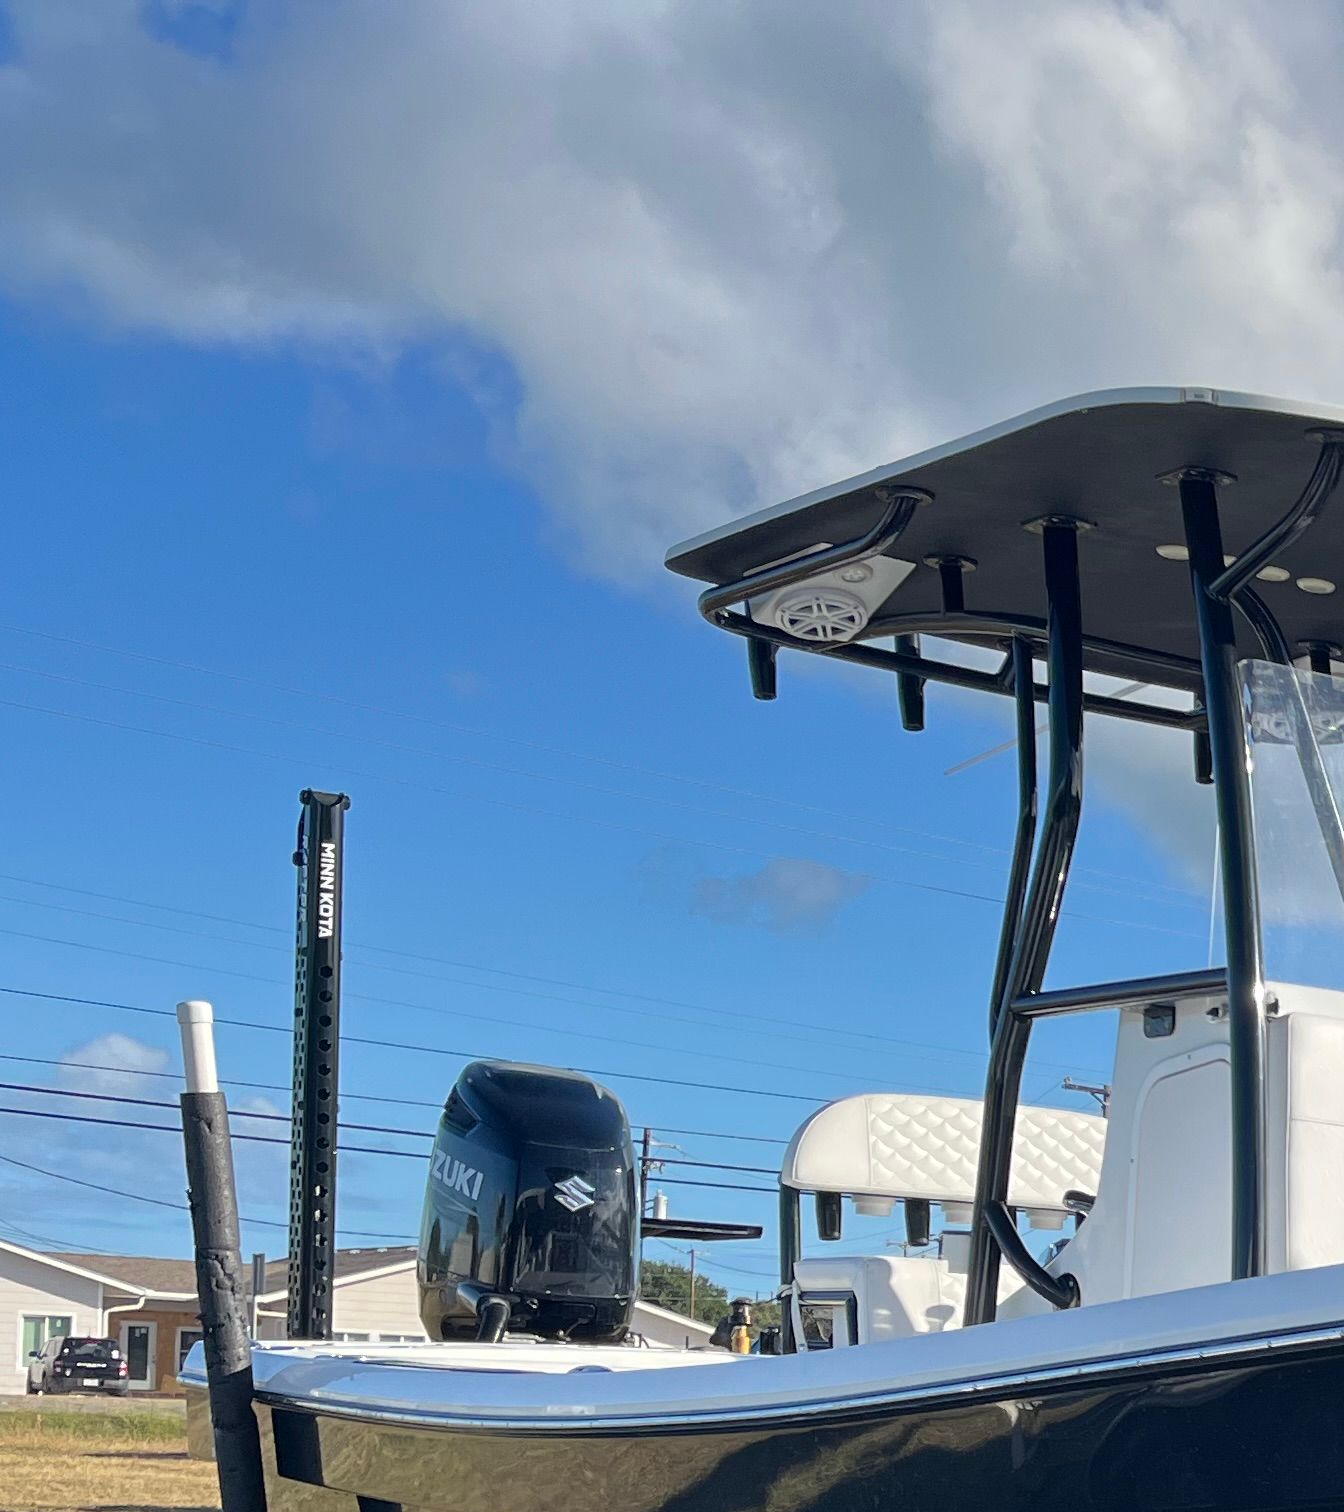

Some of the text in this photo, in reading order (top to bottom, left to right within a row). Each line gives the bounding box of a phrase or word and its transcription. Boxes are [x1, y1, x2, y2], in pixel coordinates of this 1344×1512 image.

[318, 842, 336, 938] MINN KOTA
[432, 1148, 484, 1201] ZUKI
